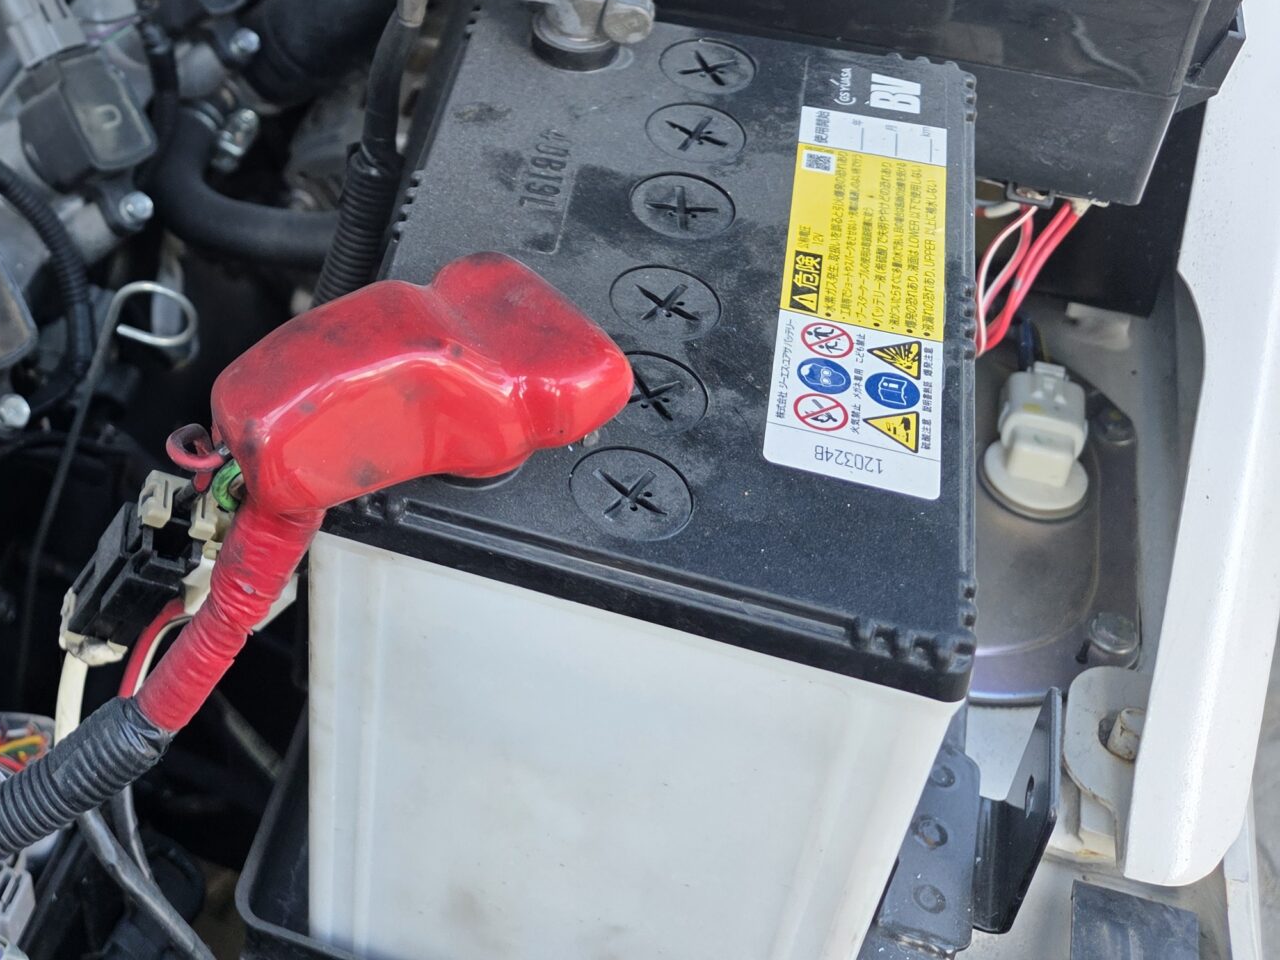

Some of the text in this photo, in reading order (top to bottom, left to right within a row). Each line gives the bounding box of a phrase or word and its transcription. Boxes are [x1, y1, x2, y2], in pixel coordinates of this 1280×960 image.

[869, 72, 921, 114] BV
[792, 253, 821, 290] 危険
[850, 402, 861, 434] 火気禁止
[813, 445, 884, 474] 120324B
